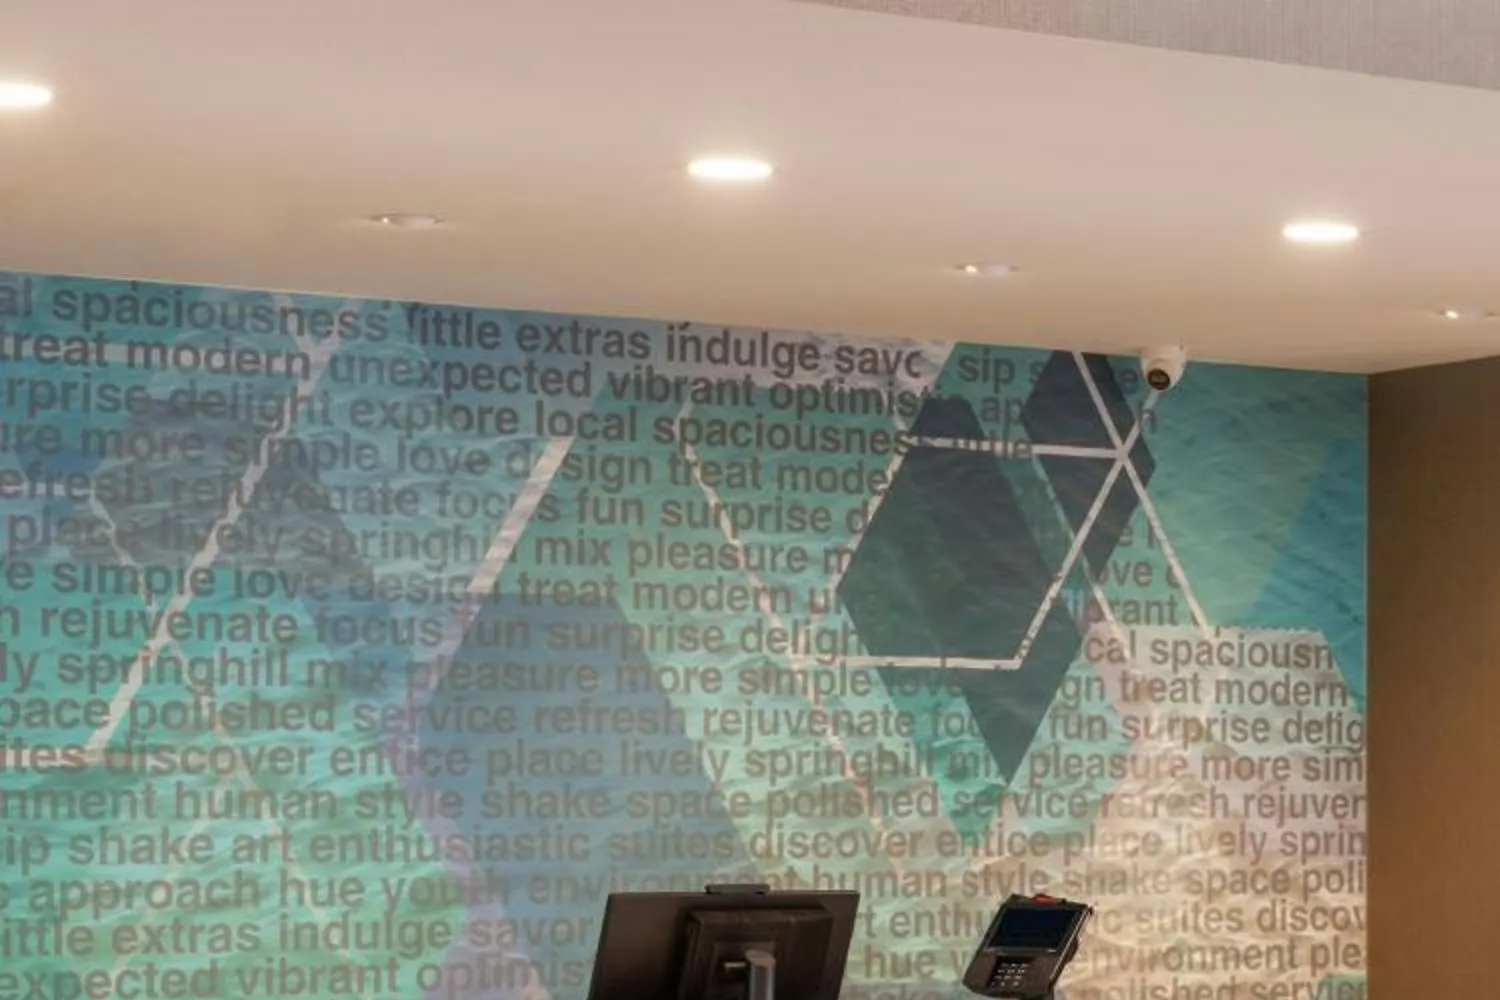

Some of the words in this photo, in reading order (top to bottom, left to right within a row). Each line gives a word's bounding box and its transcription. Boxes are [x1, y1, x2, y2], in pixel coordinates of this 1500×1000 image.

[52, 284, 388, 341] spaciousness
[515, 316, 652, 360] extras
[666, 322, 820, 376] indulge
[958, 347, 1014, 392] sip
[127, 336, 310, 379] modern
[330, 358, 592, 400] unexpected
[607, 365, 756, 408] vibrant
[350, 396, 519, 440] explore
[535, 400, 637, 442] local
[82, 427, 205, 462] more
[397, 438, 491, 475] love
[506, 440, 652, 493] dsign
[669, 456, 762, 491] treat
[436, 479, 561, 522] focs
[577, 486, 644, 527] fun
[660, 496, 833, 539] surprise
[302, 519, 518, 571] springhil
[535, 529, 611, 567] mix
[628, 532, 808, 577] pleasure
[51, 558, 217, 604] simple
[233, 560, 331, 600] love
[517, 570, 619, 609] treat
[633, 576, 792, 614] modern
[41, 600, 299, 646] rejuvenate
[316, 607, 444, 646] focus
[546, 617, 726, 660] surprise
[58, 647, 288, 698] springhill
[307, 651, 387, 692] mix
[406, 654, 598, 706] pleasure
[615, 664, 722, 696] more
[738, 660, 872, 702] simple
[1120, 671, 1203, 706] treat
[1215, 675, 1348, 707] modern
[129, 692, 335, 742] polished
[353, 697, 517, 734] service
[534, 698, 686, 735] refresh
[703, 703, 916, 745] rejuvenate
[1050, 703, 1108, 741] fun
[1121, 711, 1271, 750] surprise
[105, 737, 312, 776] discover
[330, 740, 471, 777] entice
[487, 741, 604, 784] place
[621, 741, 730, 783] lively
[744, 740, 934, 786] springhill
[1029, 742, 1189, 788] pleasure
[1202, 754, 1291, 782] more
[176, 781, 338, 820] human
[354, 781, 466, 829] style
[480, 782, 612, 820] shake
[626, 788, 751, 826] space
[768, 781, 939, 827] polished
[954, 788, 1088, 819] service
[68, 827, 214, 866] shake
[231, 828, 293, 865] art
[310, 824, 591, 864] enthusiastic
[605, 825, 735, 860] suites
[750, 823, 923, 860] discover
[936, 823, 1051, 856] entice
[1065, 824, 1163, 866] place
[1175, 823, 1267, 866] lively
[29, 871, 260, 919] approach
[280, 868, 365, 906] hue
[384, 868, 510, 916] youth
[813, 864, 948, 899] human
[962, 862, 1051, 898] style
[1065, 864, 1171, 896] shake
[1187, 867, 1290, 900] space
[111, 917, 261, 955] extras
[280, 912, 452, 960] indulge
[469, 917, 594, 948] savor
[1137, 904, 1243, 934] suites
[237, 958, 401, 998] vibrant
[864, 945, 936, 978] hue
